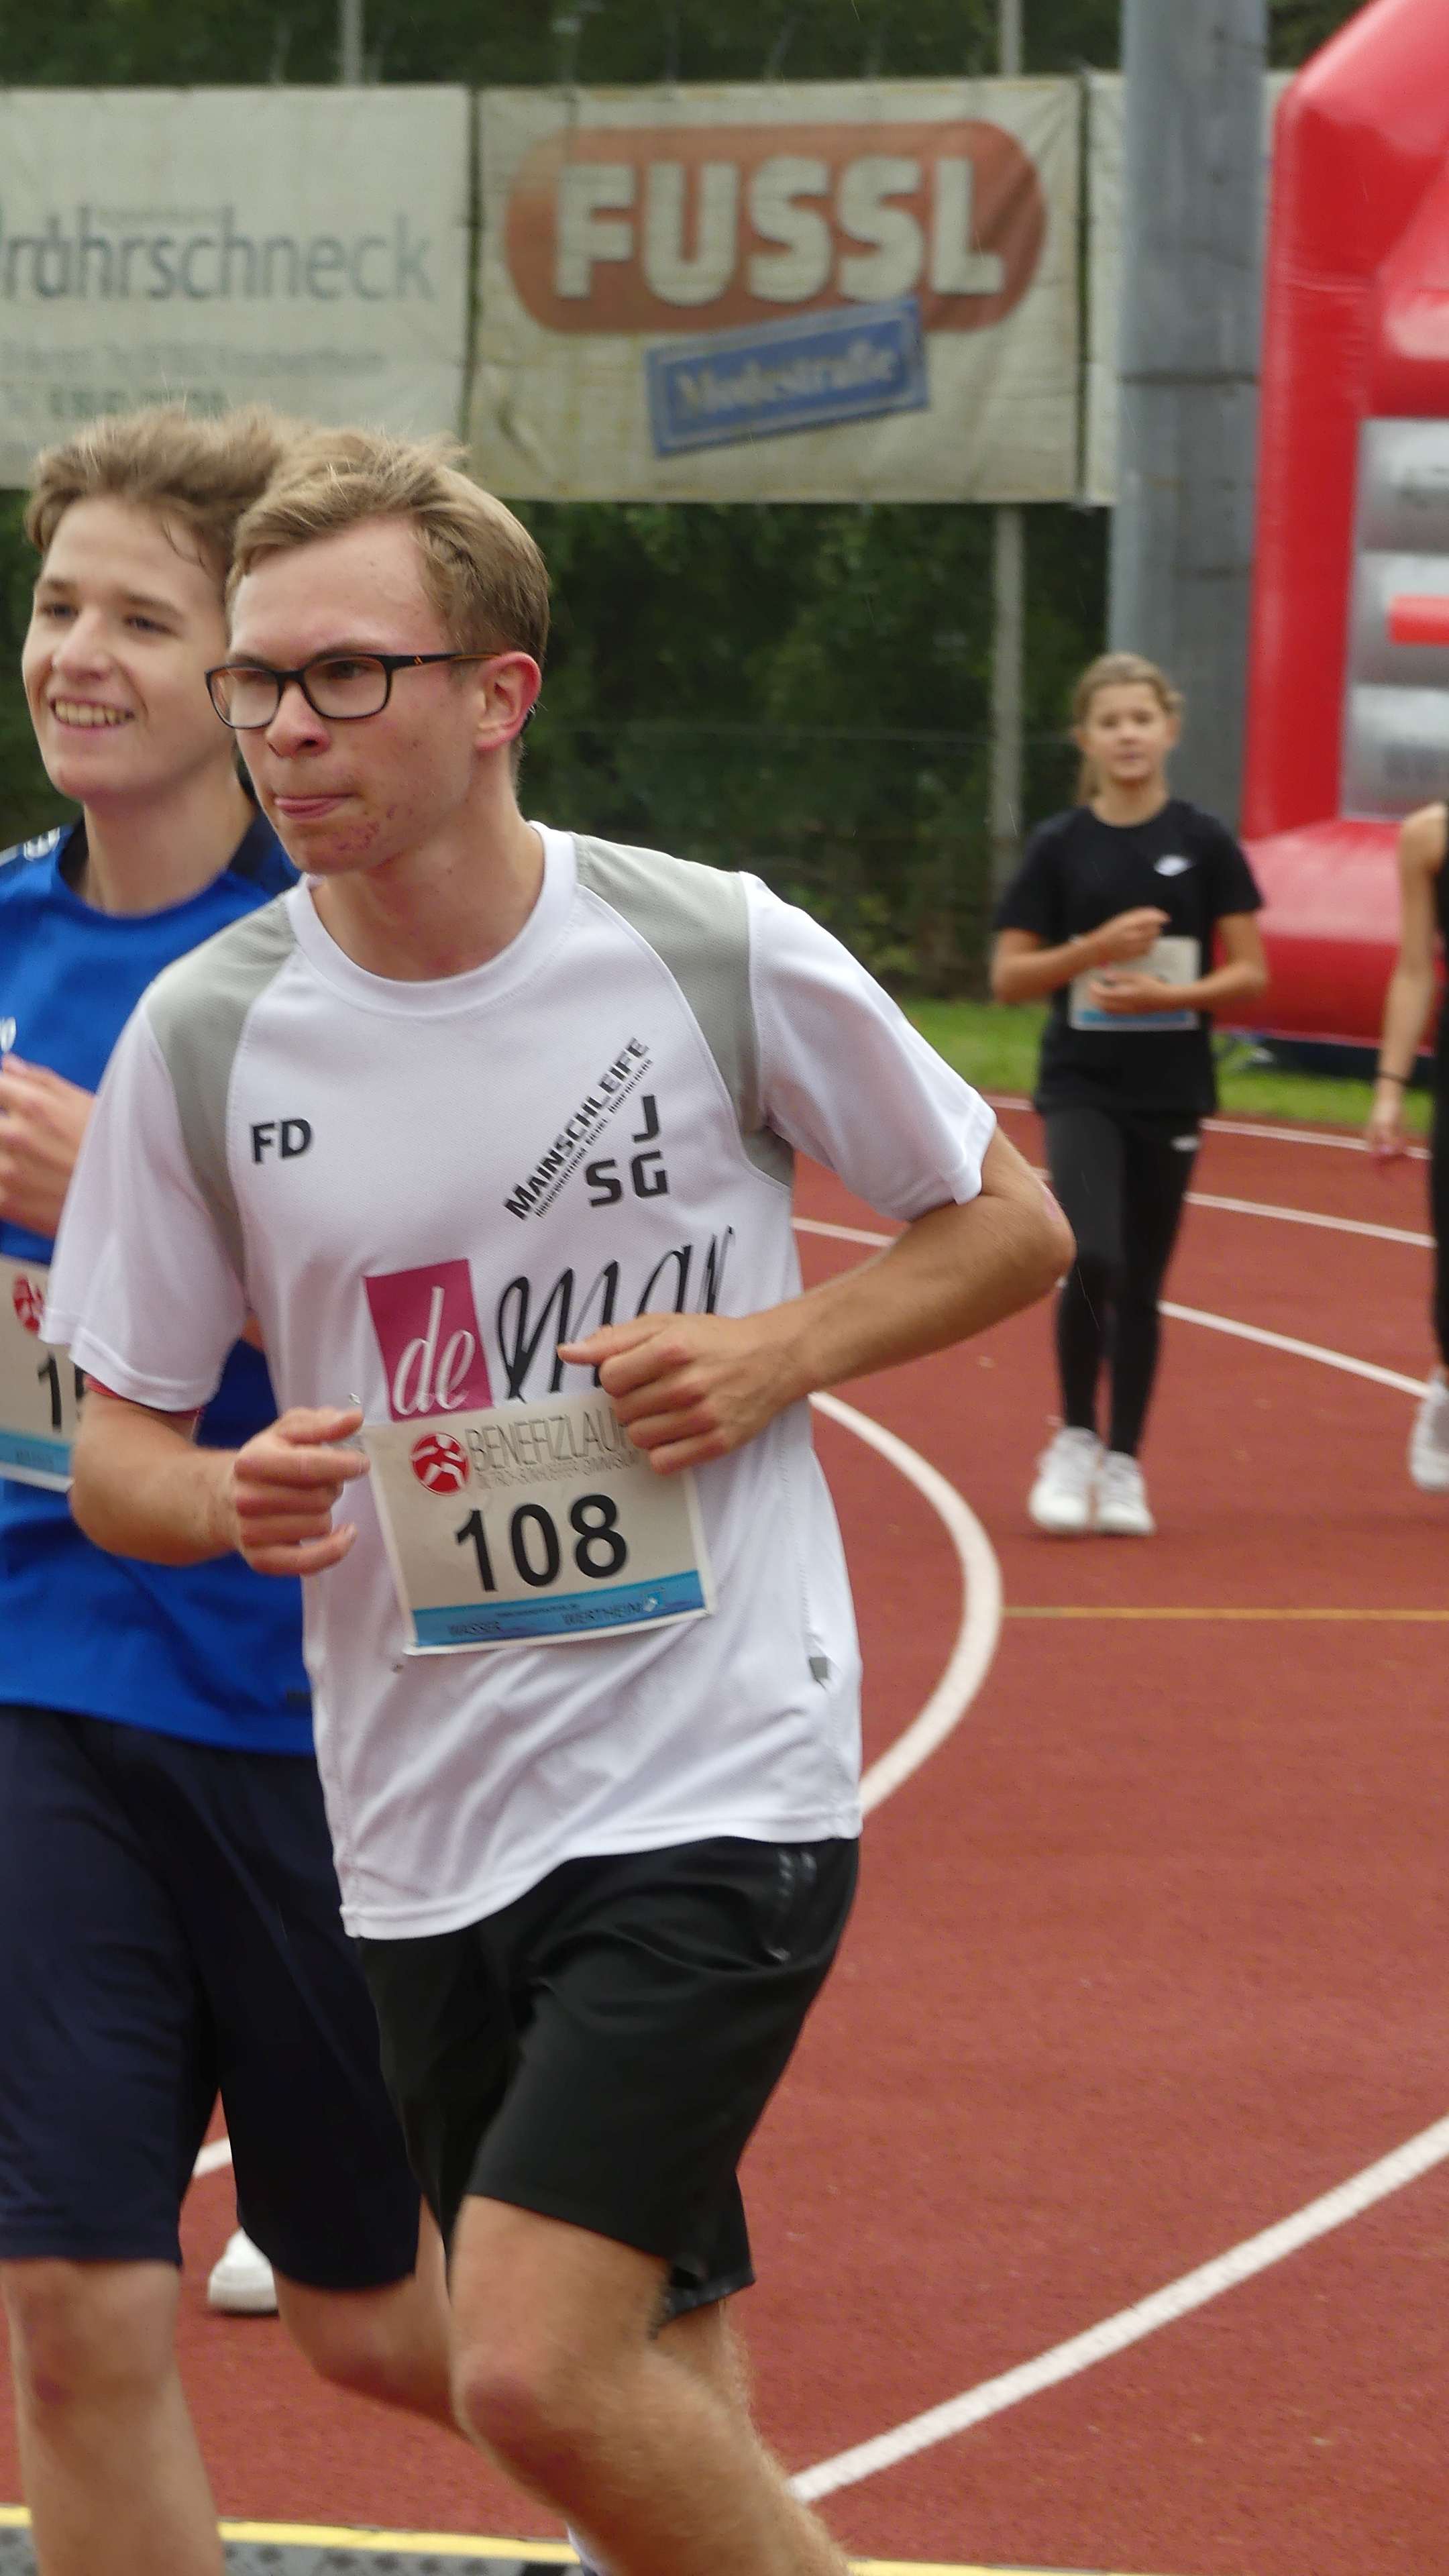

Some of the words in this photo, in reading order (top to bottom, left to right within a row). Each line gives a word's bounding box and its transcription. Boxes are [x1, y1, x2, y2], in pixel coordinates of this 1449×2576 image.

[553, 156, 1005, 306] FUSSL
[251, 1117, 313, 1164] FD
[504, 1037, 649, 1220] MAINSCHLEIFE
[633, 1093, 659, 1143] J
[456, 1494, 629, 1593] 108
